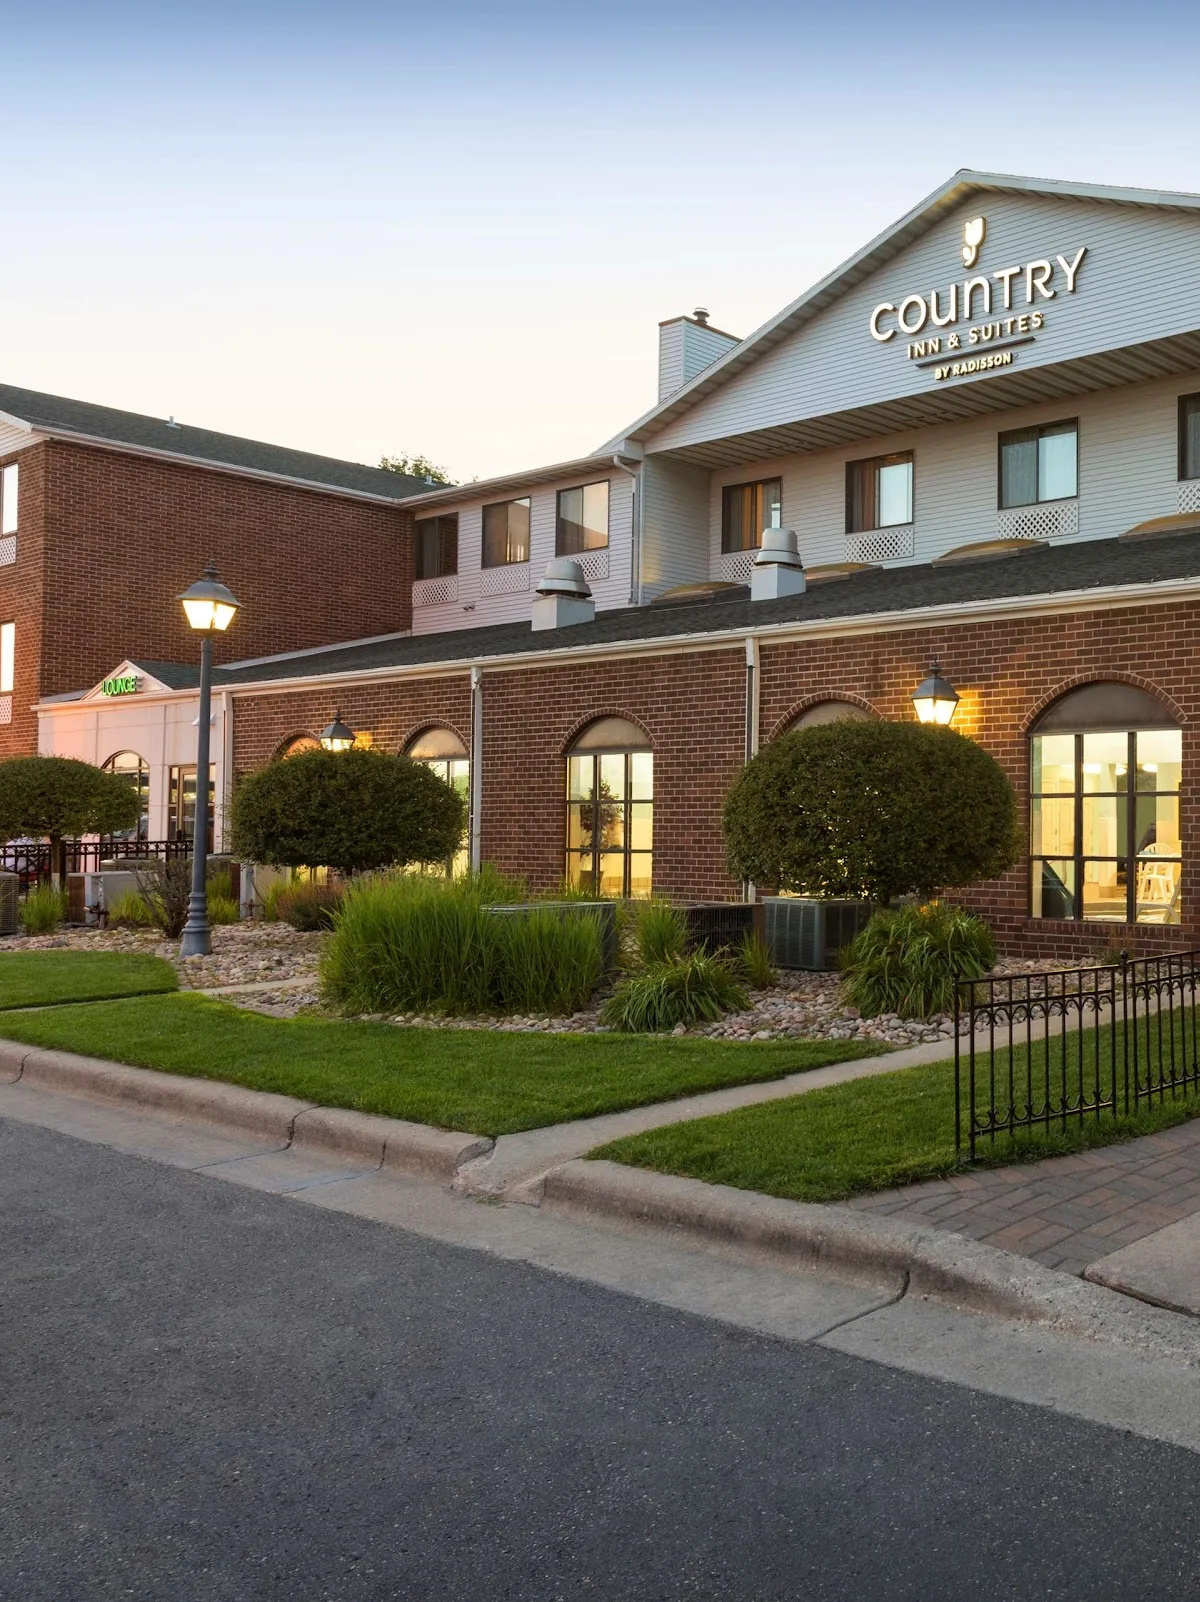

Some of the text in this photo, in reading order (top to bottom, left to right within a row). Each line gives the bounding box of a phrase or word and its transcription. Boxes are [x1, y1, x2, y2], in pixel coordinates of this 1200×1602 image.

[870, 247, 1088, 341] COUNTRY
[907, 311, 1044, 359] INN & SUITES
[935, 352, 1013, 380] BY RADISSON
[102, 676, 137, 696] LOUNGE
